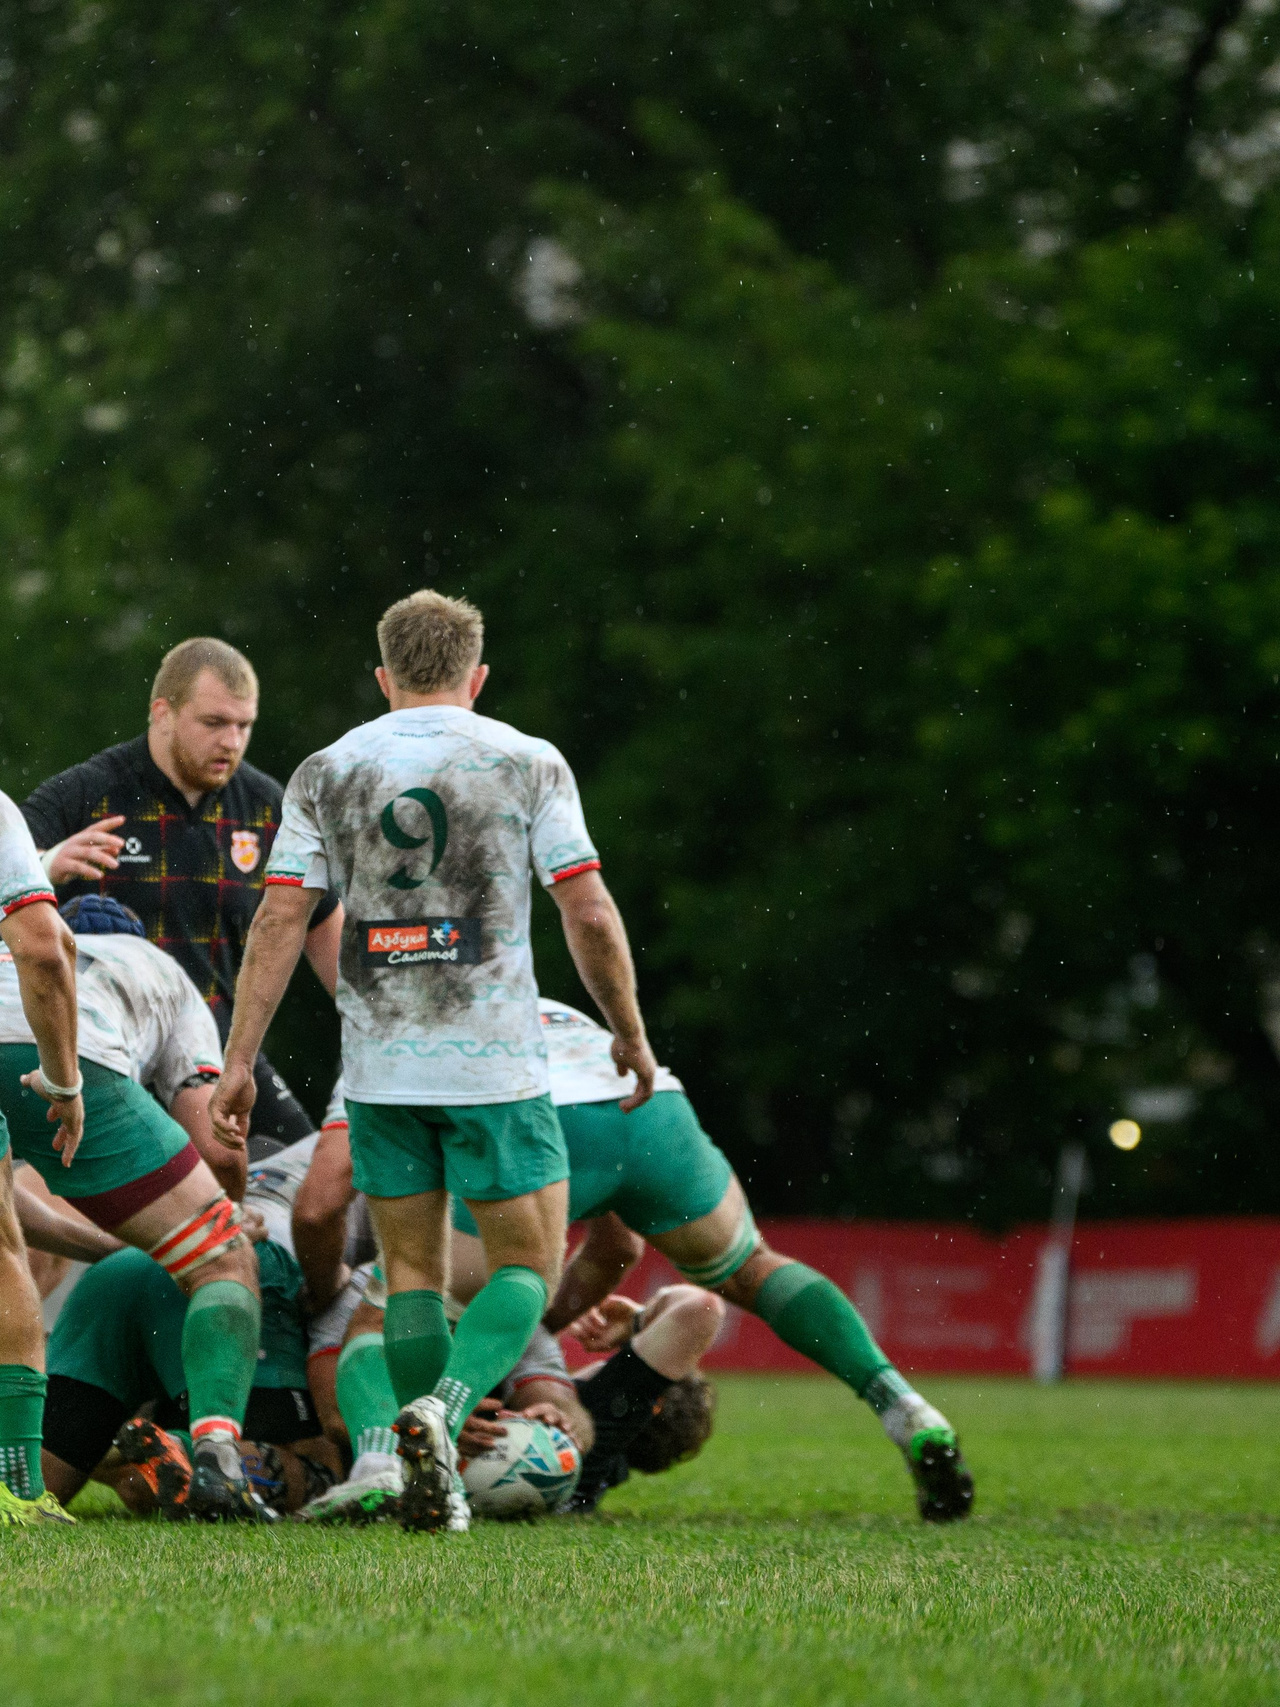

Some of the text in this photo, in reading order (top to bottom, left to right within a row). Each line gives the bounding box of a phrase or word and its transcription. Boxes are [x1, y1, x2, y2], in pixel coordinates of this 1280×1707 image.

[380, 787, 448, 890] 9
[371, 931, 426, 949] Азбука
[387, 947, 458, 964] Салютов
